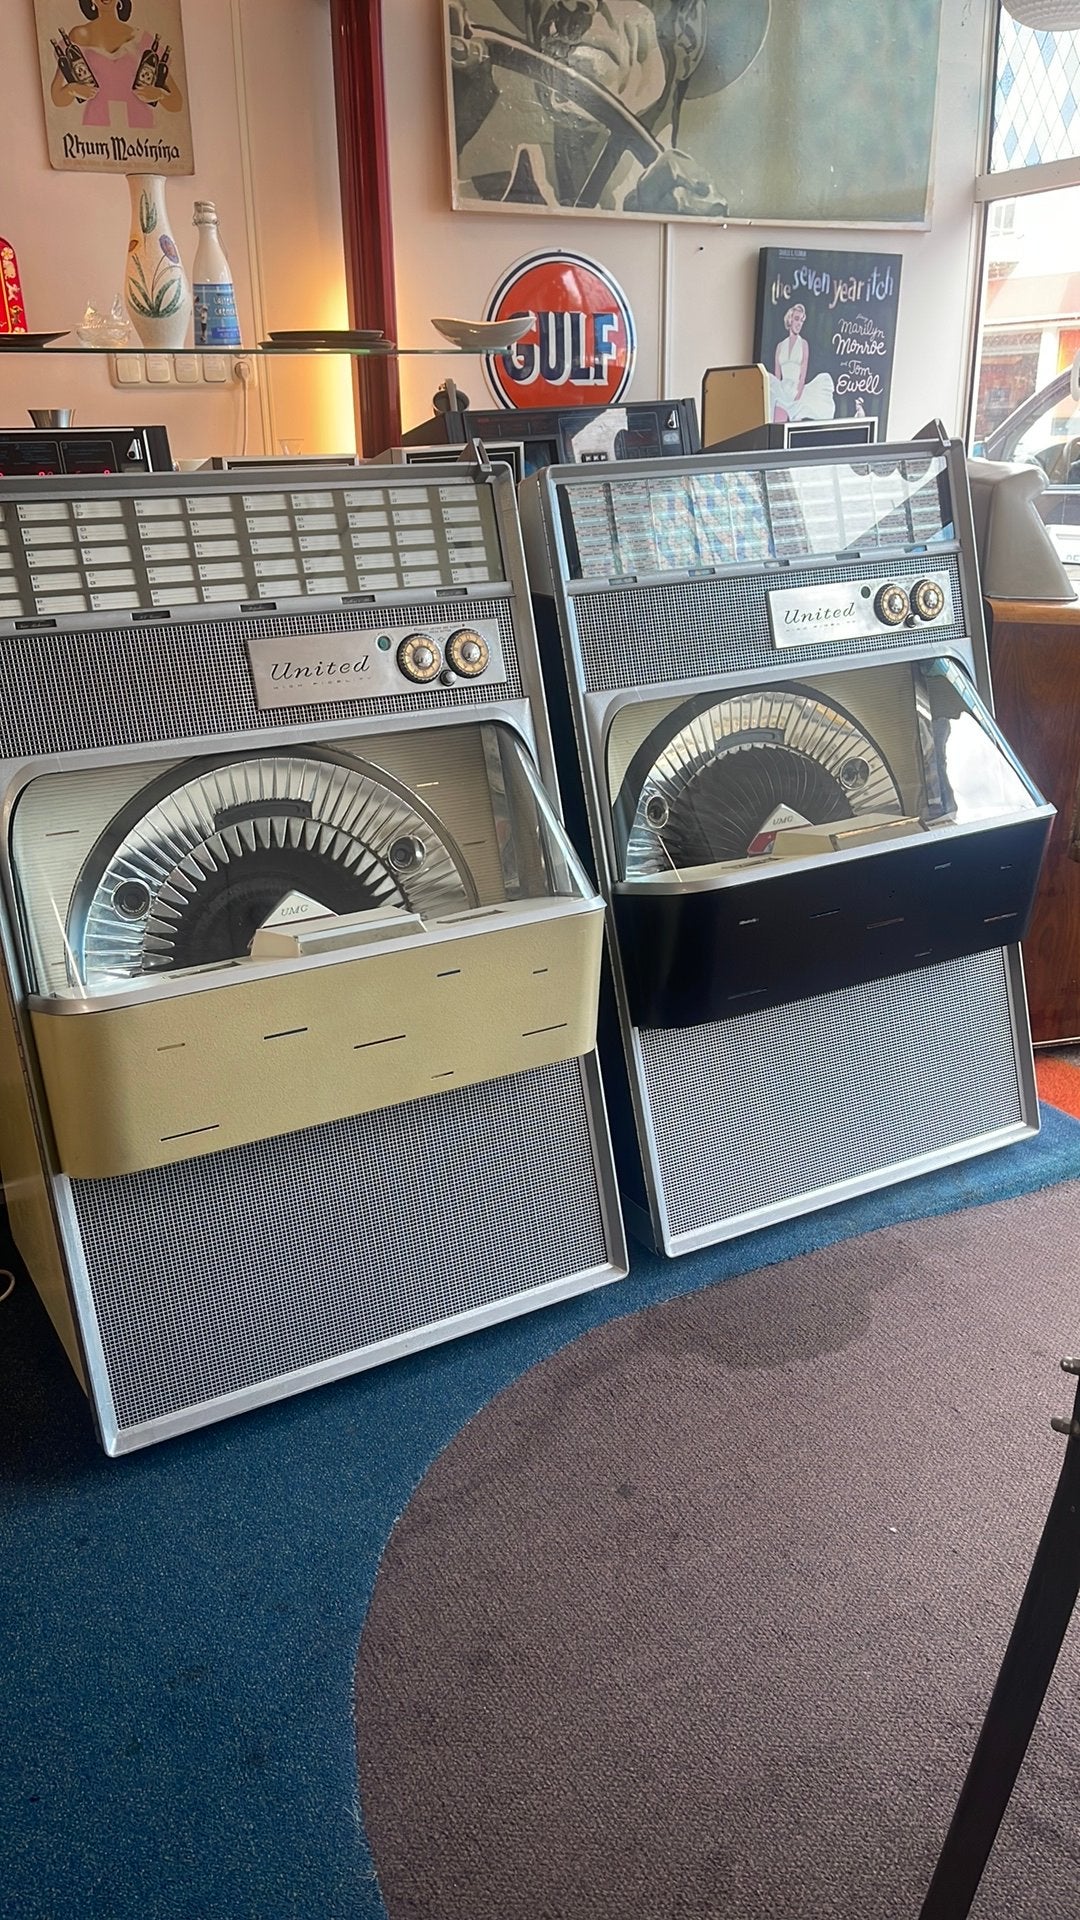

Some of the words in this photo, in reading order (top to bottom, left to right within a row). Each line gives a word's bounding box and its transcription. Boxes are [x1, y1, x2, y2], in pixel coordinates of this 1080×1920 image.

[63, 132, 110, 159] Rhum
[772, 273, 791, 305] the
[792, 265, 830, 297] seven
[828, 276, 865, 309] year
[865, 265, 894, 302] itch
[838, 318, 885, 342] Marilyn
[502, 311, 619, 386] GULF
[832, 333, 887, 356] Monroe
[848, 360, 872, 376] Tom
[836, 374, 884, 395] Ewell
[783, 602, 856, 625] United
[271, 655, 370, 681] United
